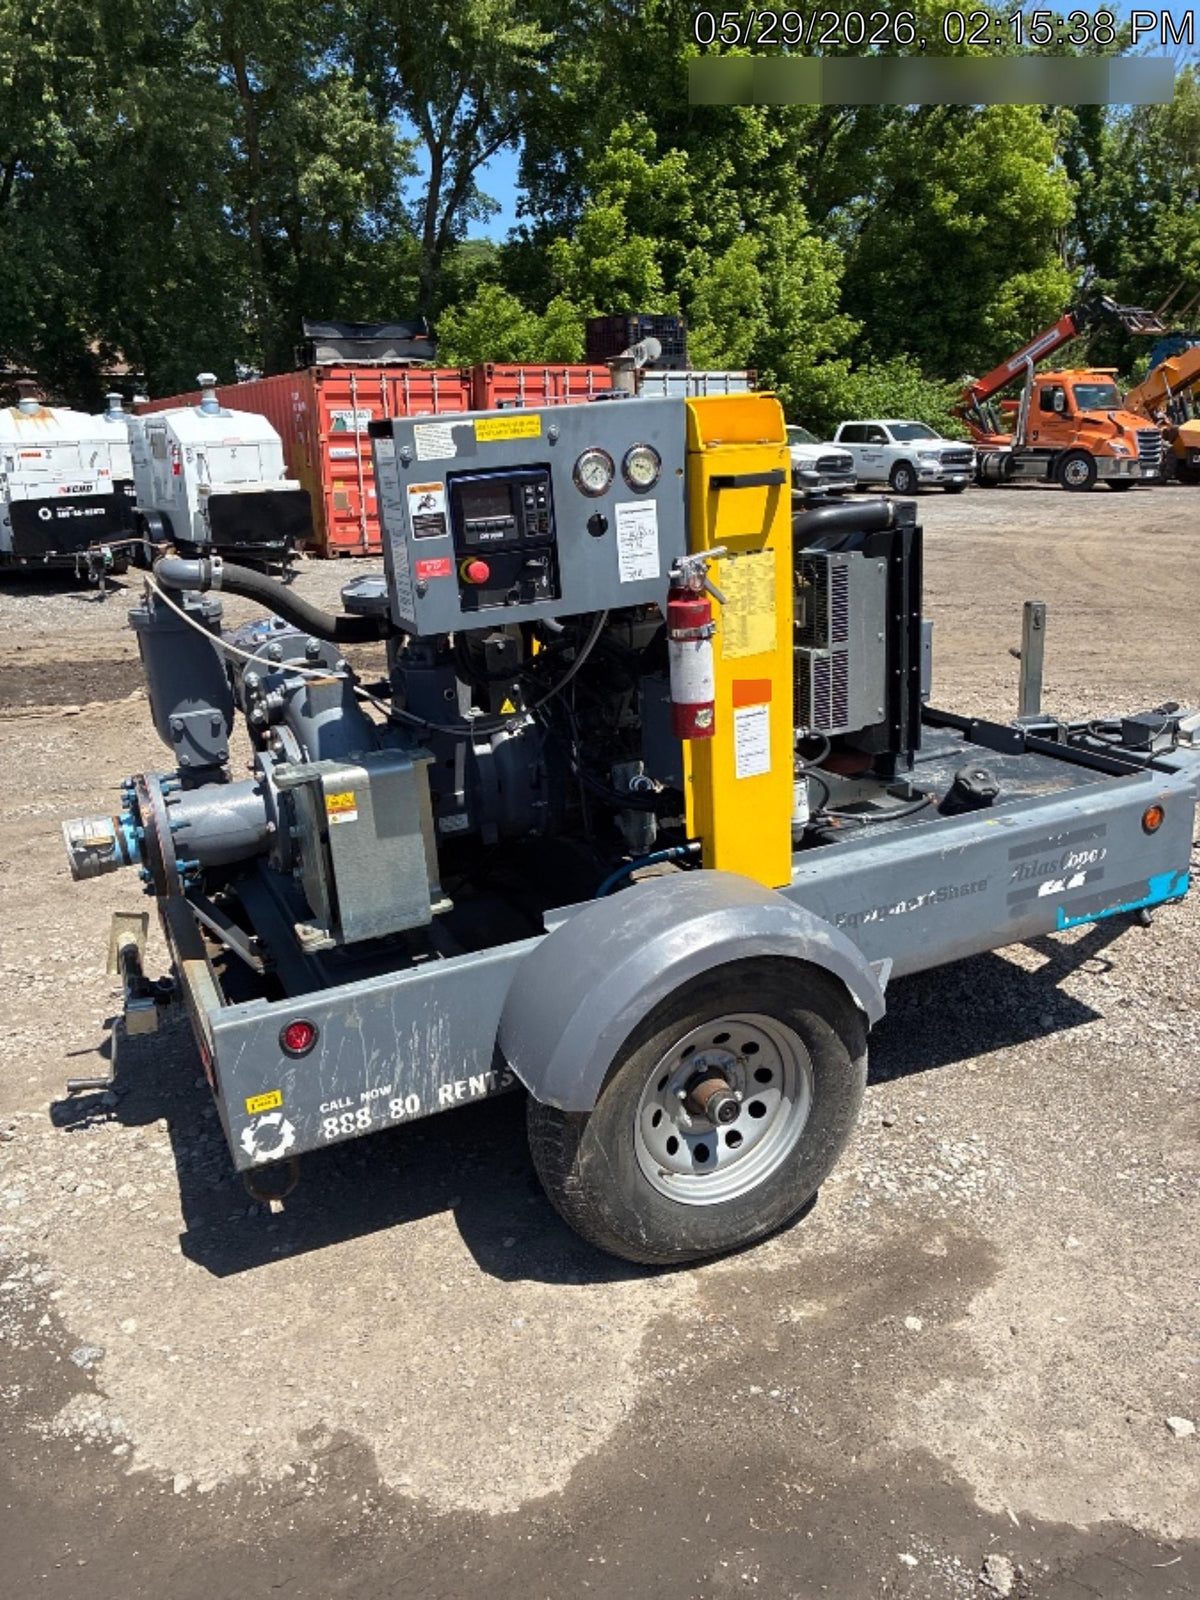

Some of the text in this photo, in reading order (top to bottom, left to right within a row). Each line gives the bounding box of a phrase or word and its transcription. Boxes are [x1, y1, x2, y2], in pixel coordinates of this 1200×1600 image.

[1008, 847, 1107, 885] Atlas Copco
[319, 1084, 393, 1114] CALL NOW
